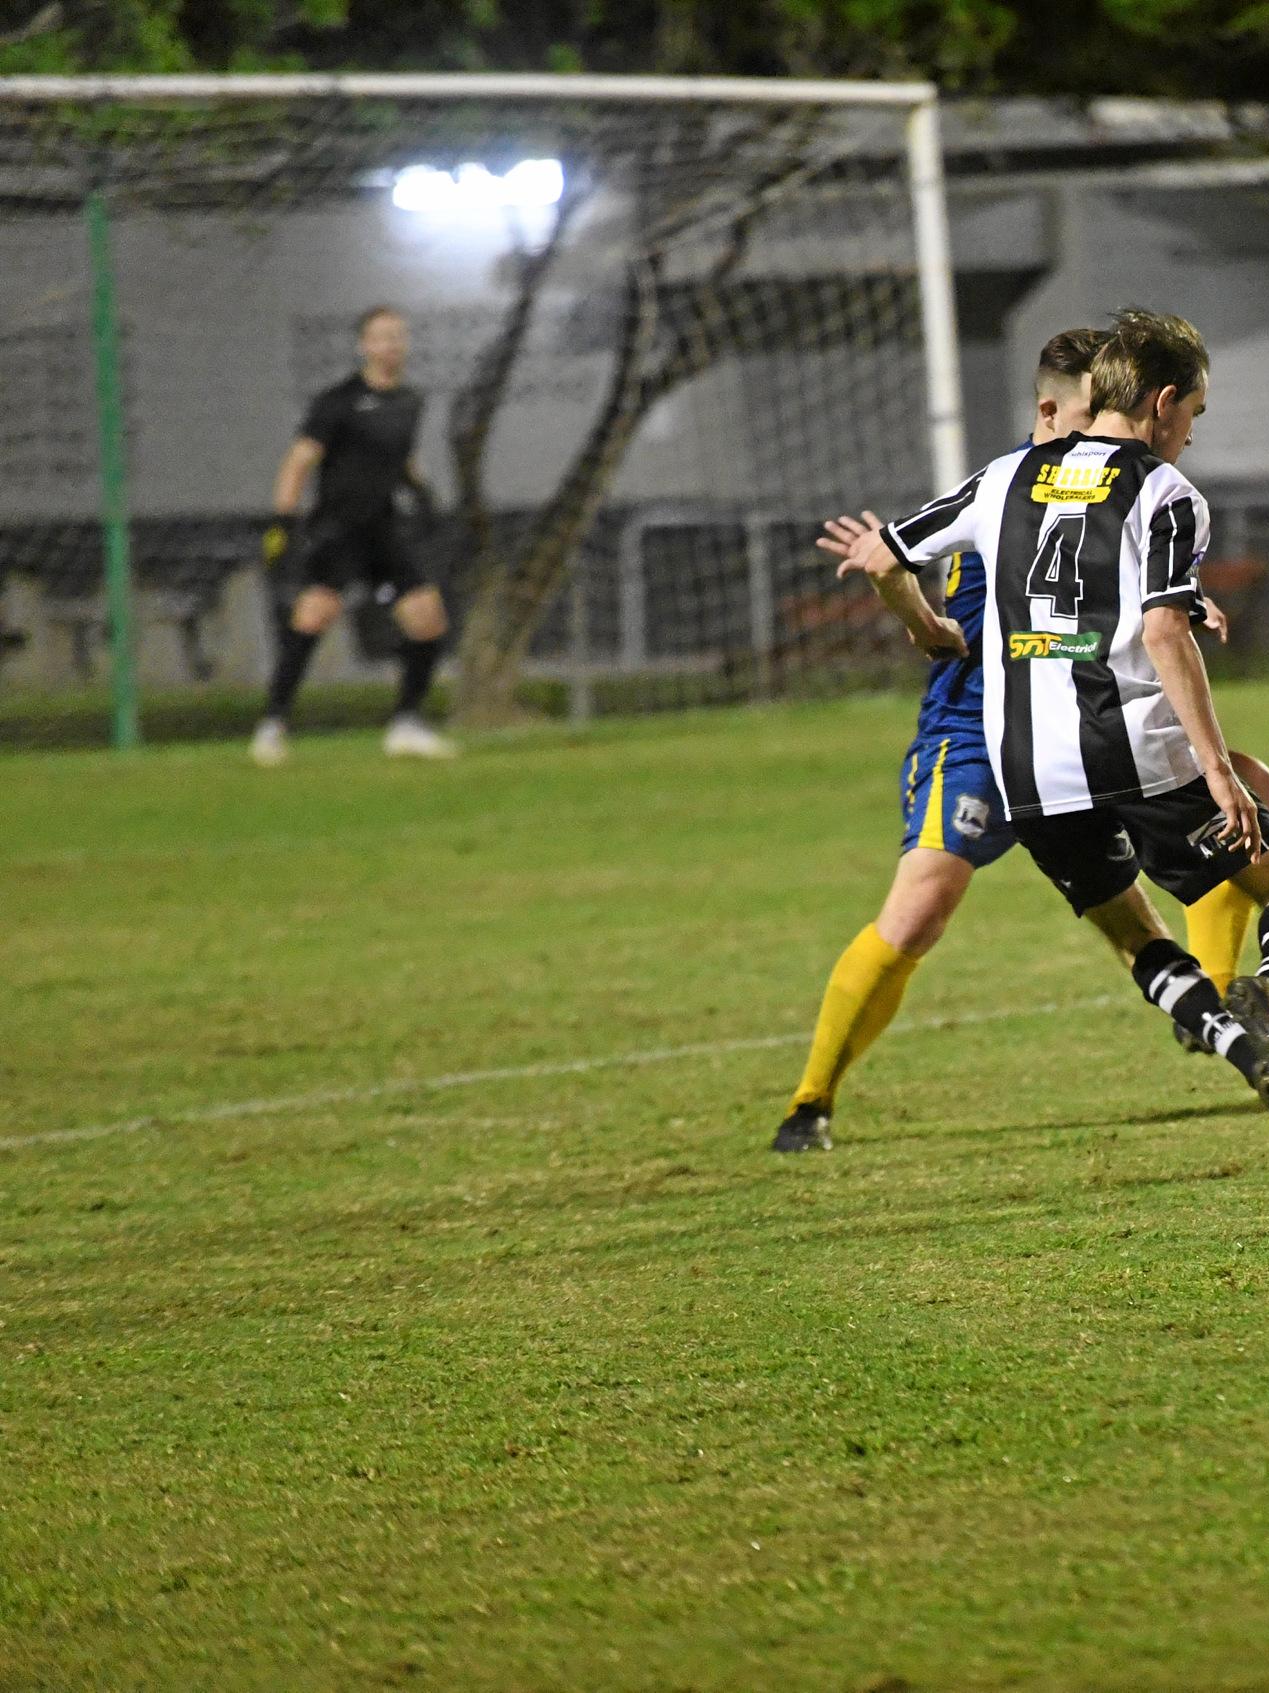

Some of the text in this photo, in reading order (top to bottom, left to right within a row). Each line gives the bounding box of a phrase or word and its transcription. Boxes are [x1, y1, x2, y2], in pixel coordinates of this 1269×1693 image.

[1044, 492, 1096, 501] WHOLESALERS
[1051, 488, 1093, 496] ELECTRICAL
[1025, 512, 1087, 619] 4
